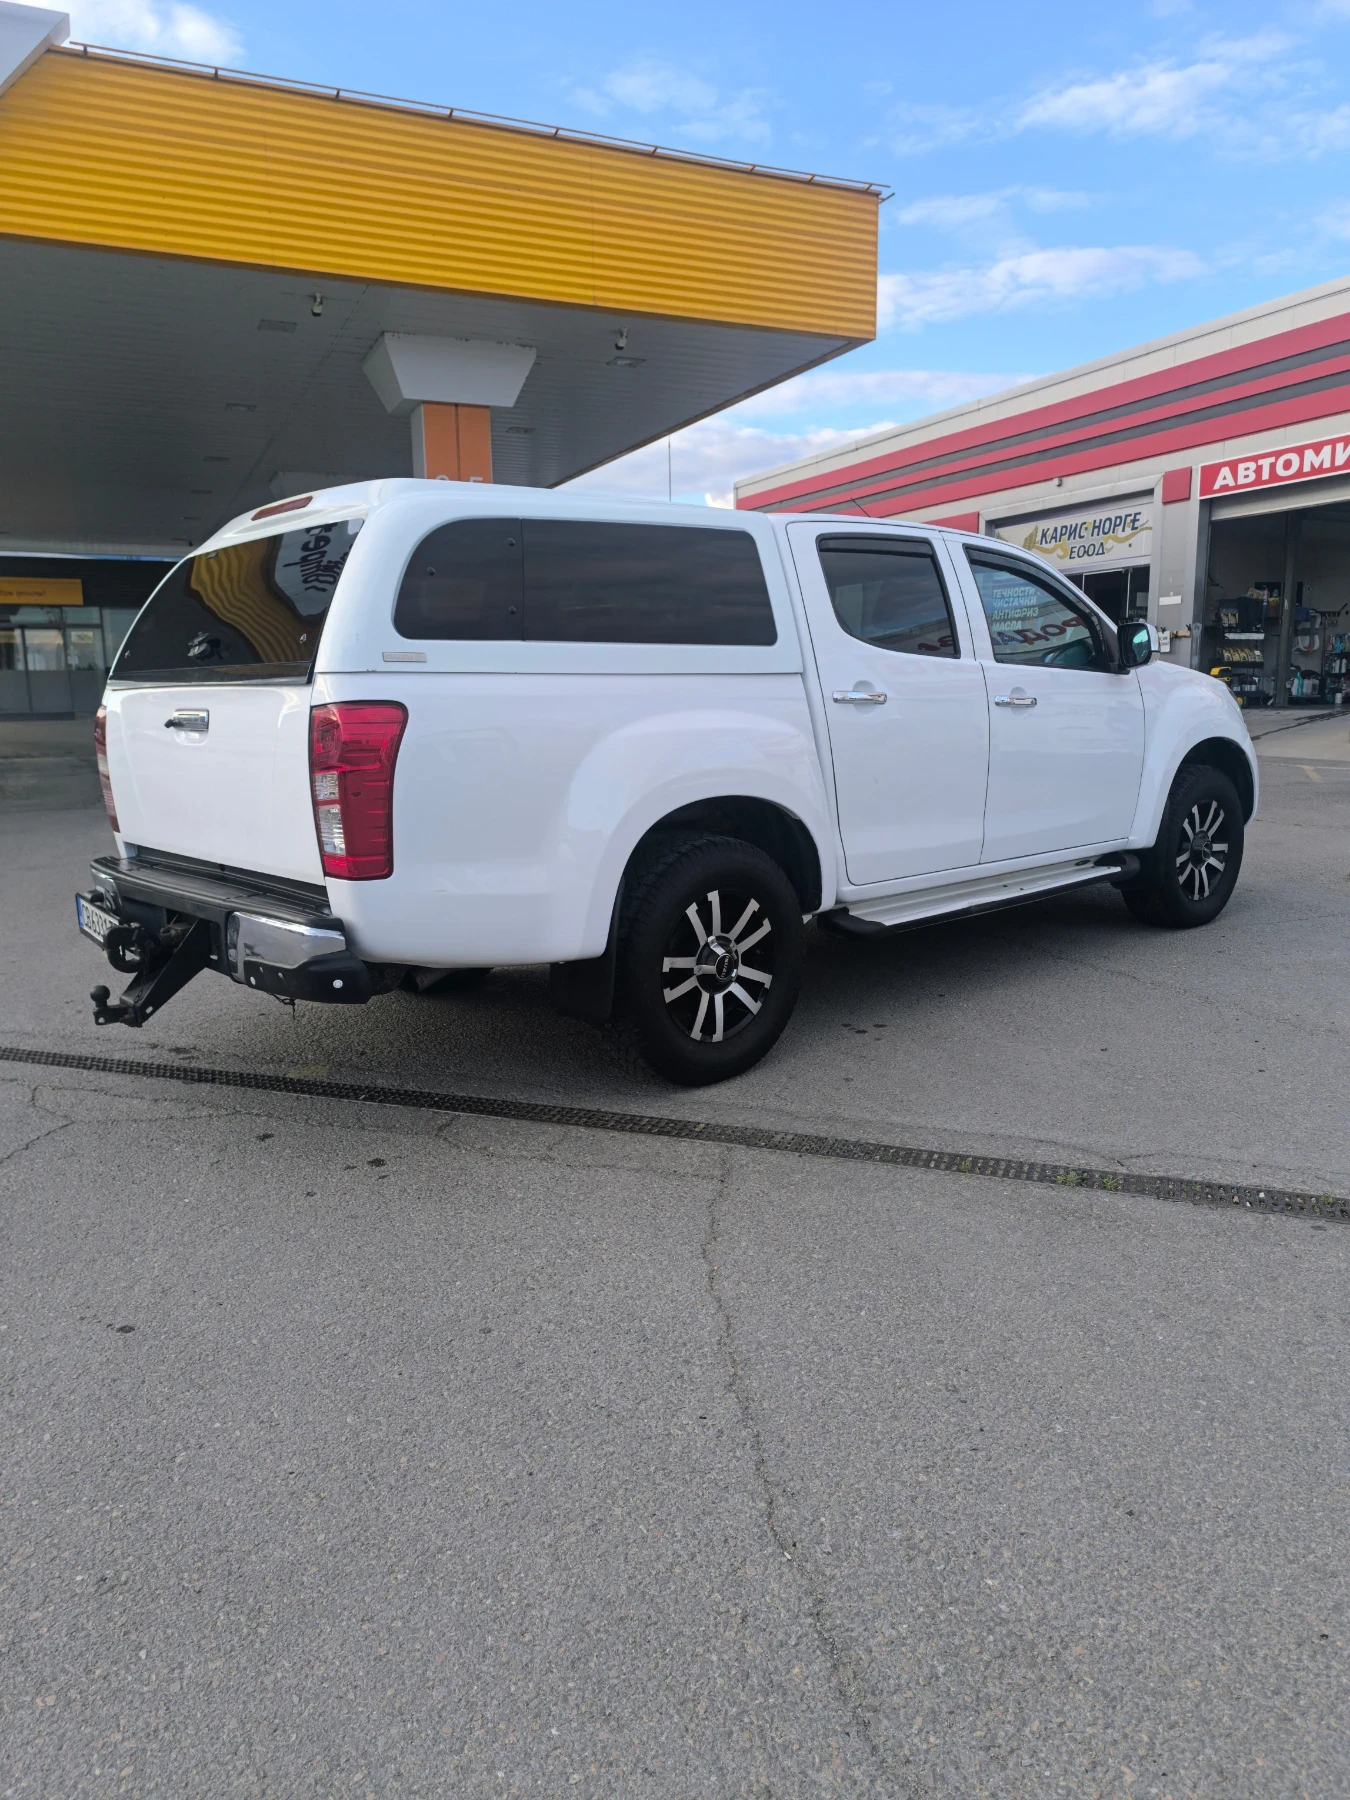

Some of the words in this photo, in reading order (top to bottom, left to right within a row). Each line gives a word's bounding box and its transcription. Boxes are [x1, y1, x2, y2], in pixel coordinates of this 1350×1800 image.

[1040, 522, 1087, 545] КАРИС
[1091, 512, 1141, 537] НОРГЕ
[1069, 542, 1105, 559] ЕООД
[993, 586, 1035, 598] ТЕЧНОСТИ
[993, 596, 1036, 607] ЧИСТАЧКИ
[992, 607, 1038, 620] АНТИФРИЗ
[992, 620, 1022, 631] МАСЛА
